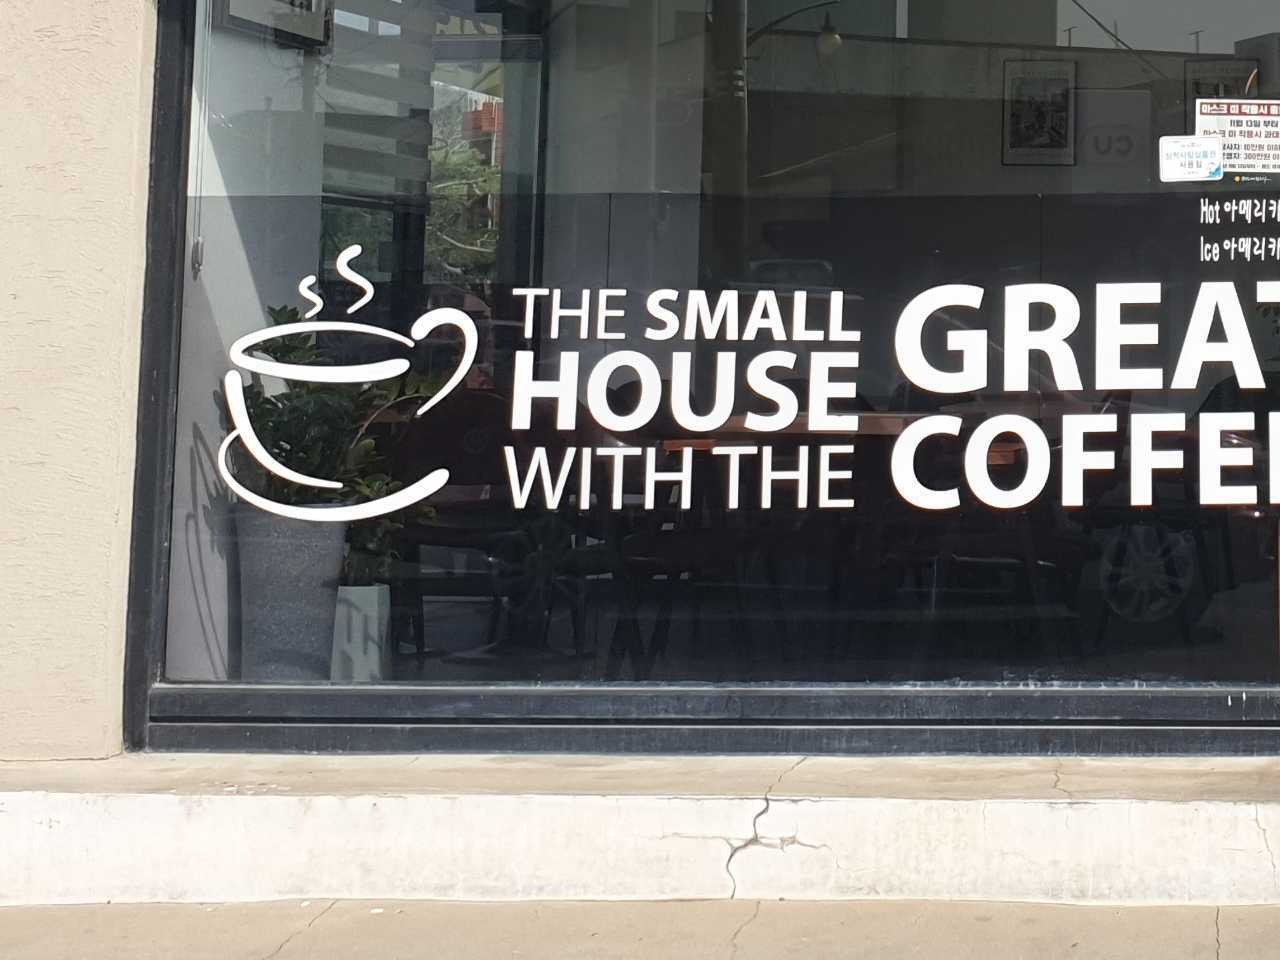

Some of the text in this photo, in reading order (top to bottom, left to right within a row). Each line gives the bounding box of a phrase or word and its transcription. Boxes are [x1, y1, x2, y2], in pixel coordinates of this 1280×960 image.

[1201, 103, 1228, 114] 마스크
[1200, 198, 1221, 224] Hot
[1200, 236, 1220, 262] Ice
[512, 287, 862, 343] THE SMALL
[510, 350, 861, 432] HOUSE
[504, 445, 856, 511] WITH THE
